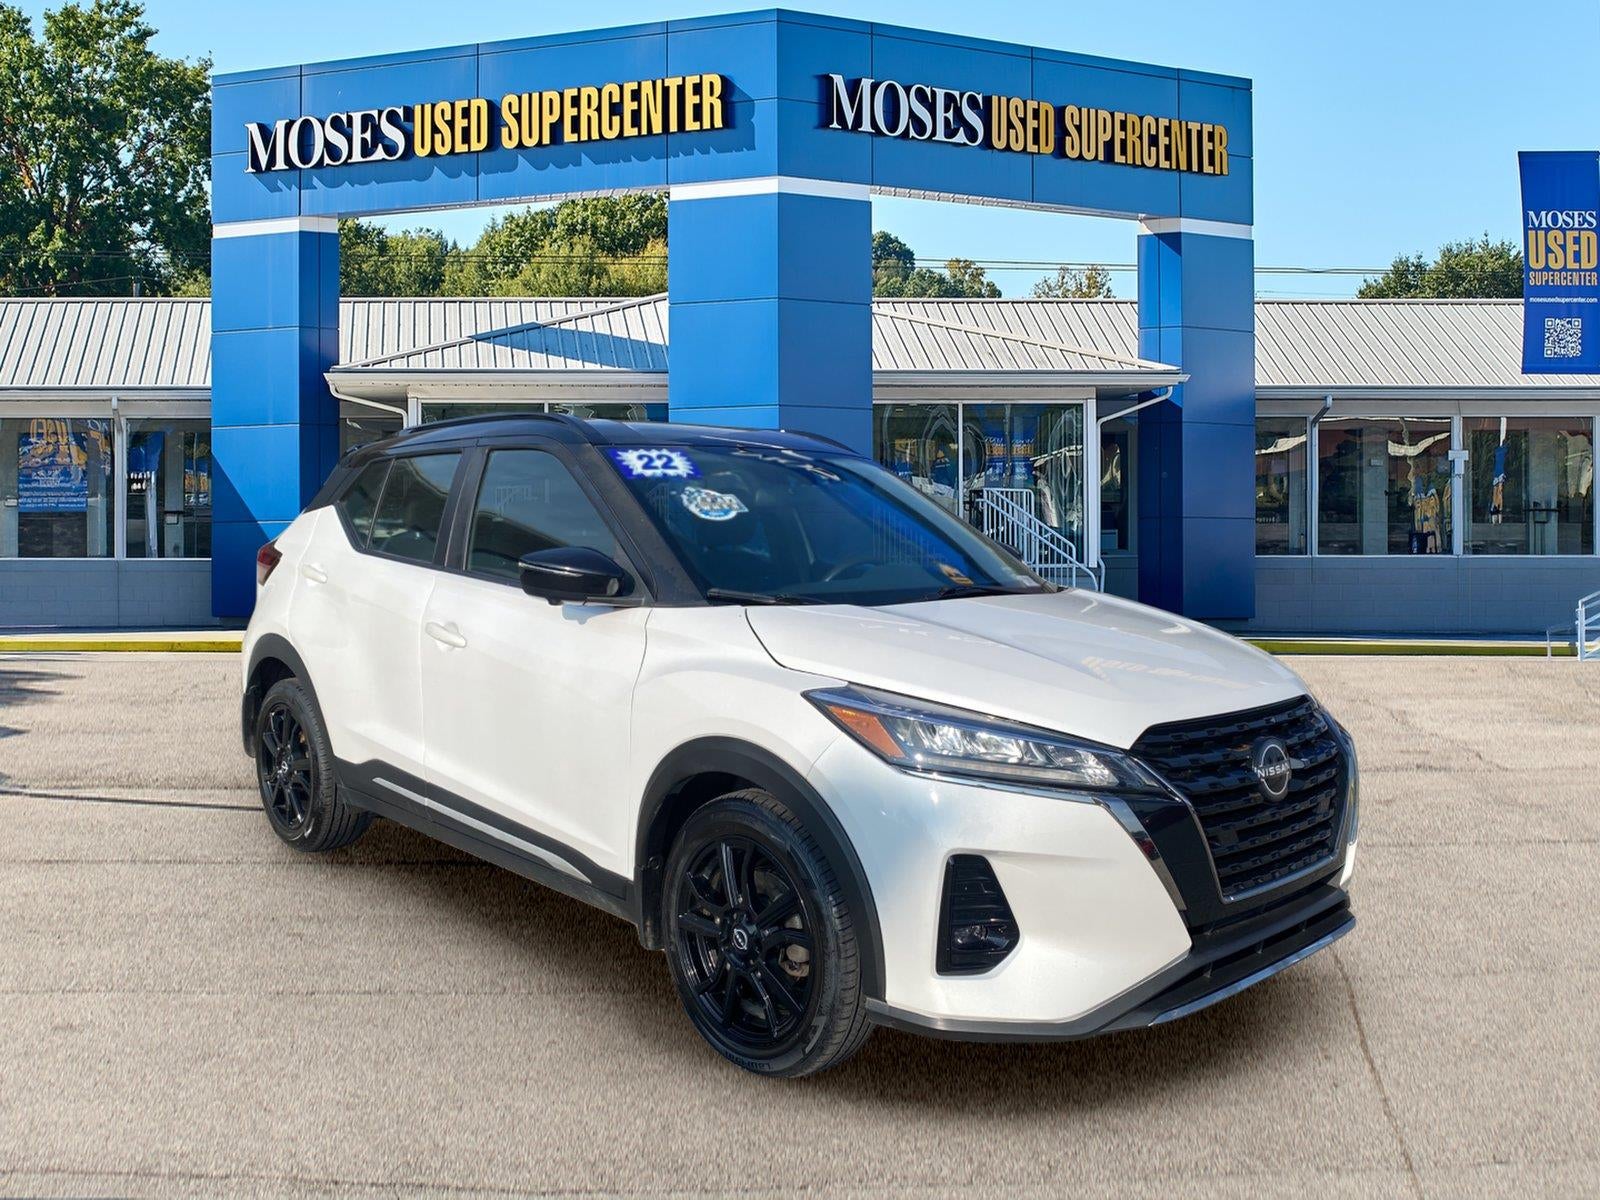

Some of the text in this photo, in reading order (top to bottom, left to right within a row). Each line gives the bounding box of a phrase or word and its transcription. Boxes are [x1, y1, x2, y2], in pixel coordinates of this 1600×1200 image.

[244, 72, 724, 173] MOSES USED SUPERCENTER
[828, 73, 1230, 176] MOSES USED SUPERCENTER
[1527, 210, 1597, 229] MOSES
[1528, 230, 1598, 270] USED
[1529, 271, 1598, 287] SUPERCENTER
[637, 453, 679, 470] 22
[1257, 762, 1290, 778] NISSAN
